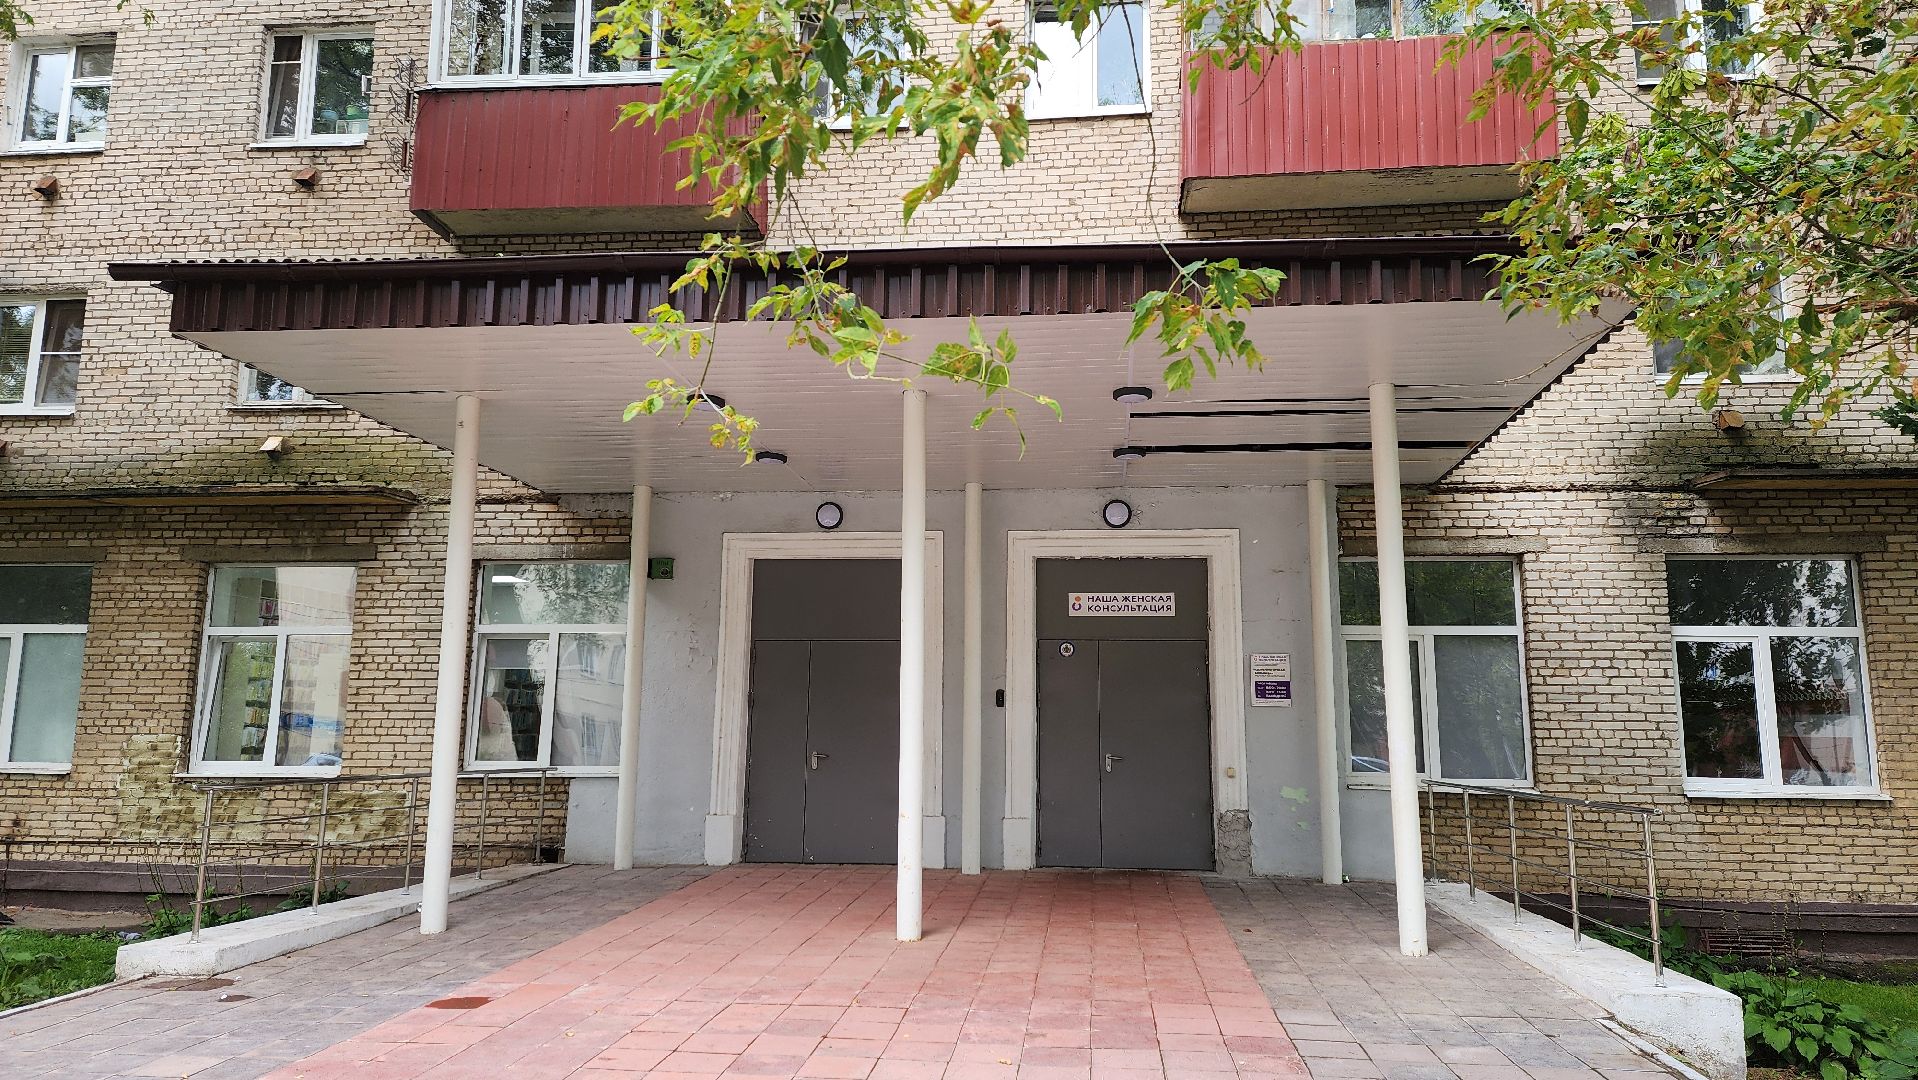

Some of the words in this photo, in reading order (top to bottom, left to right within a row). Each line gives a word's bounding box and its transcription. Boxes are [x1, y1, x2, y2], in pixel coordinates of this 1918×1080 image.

[1087, 595, 1120, 603] НАША
[1121, 595, 1172, 603] ЖЕНСКАЯ
[1087, 604, 1172, 613] КОНСУЛЬТАЦИЯ
